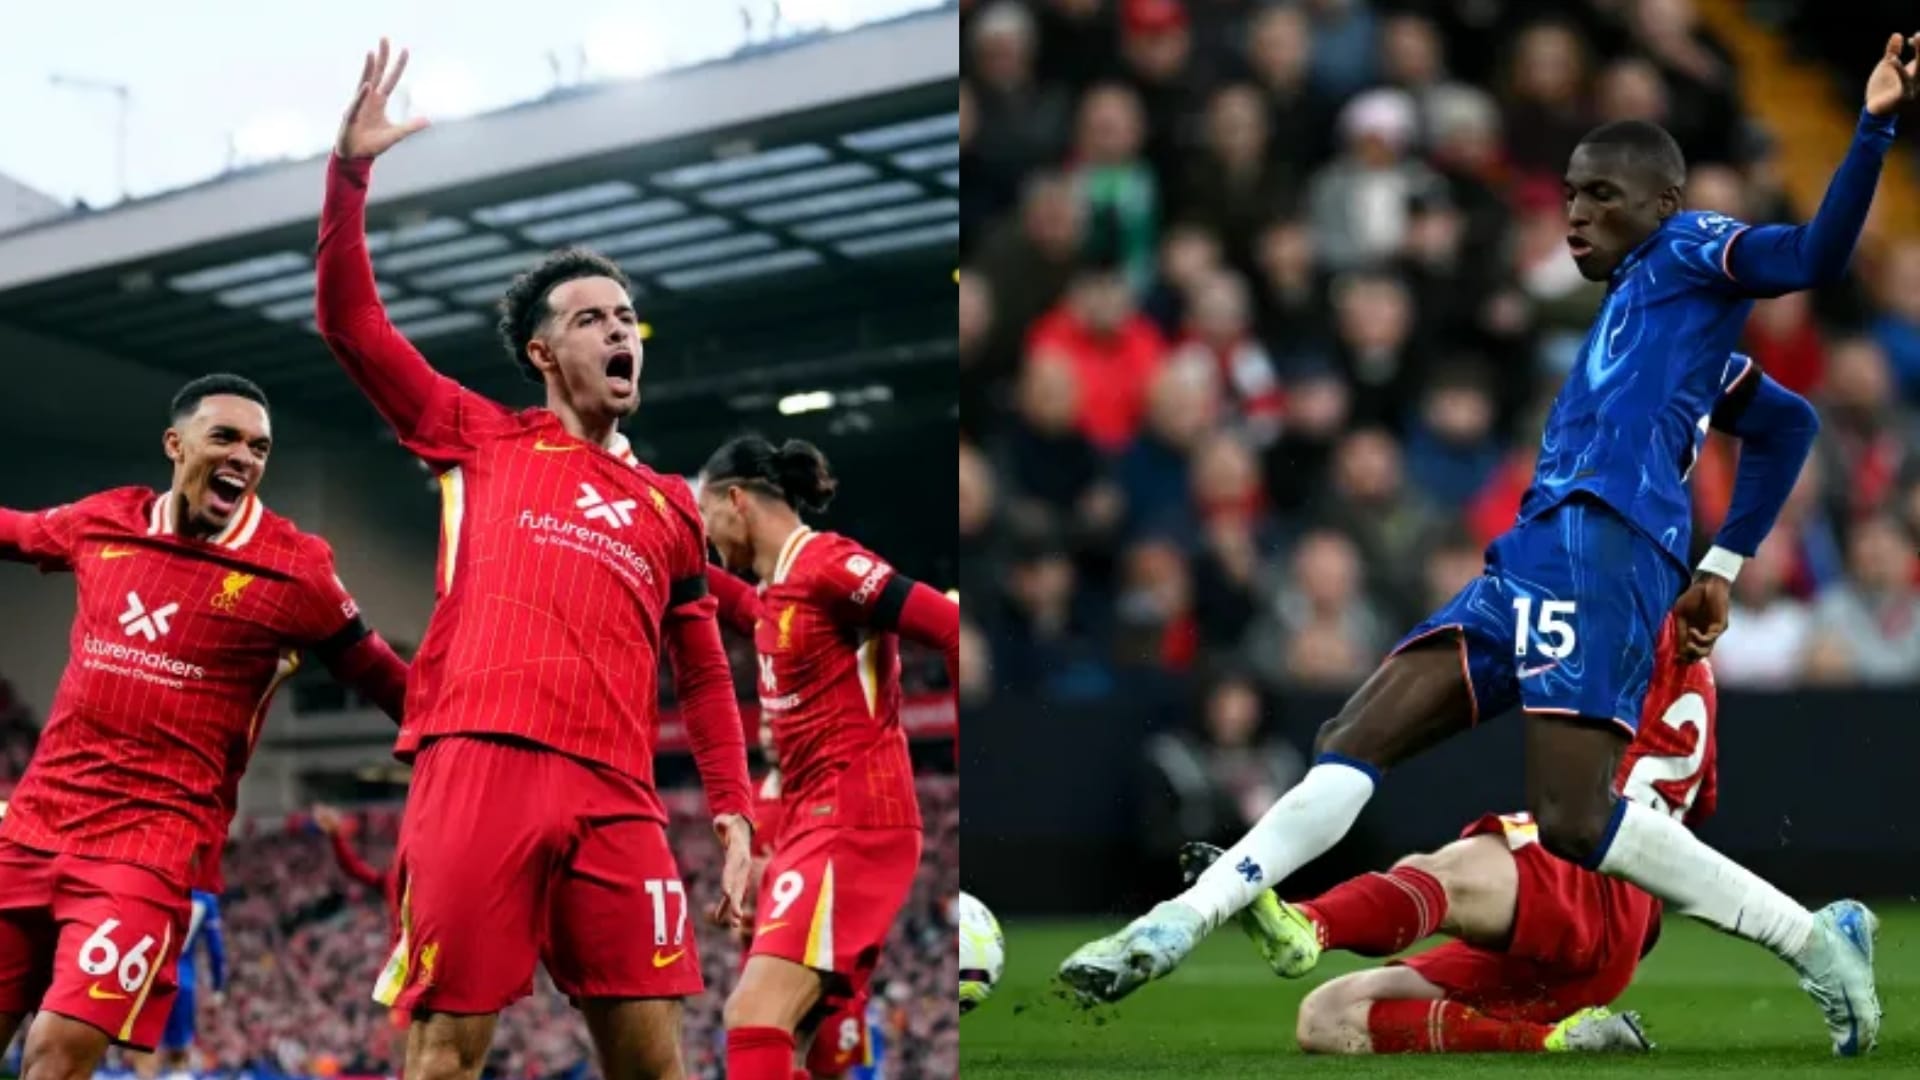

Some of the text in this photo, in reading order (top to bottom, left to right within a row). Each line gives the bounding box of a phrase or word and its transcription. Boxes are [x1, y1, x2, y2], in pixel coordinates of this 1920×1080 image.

[518, 508, 654, 585] futuremakers
[1512, 597, 1577, 659] 15
[644, 878, 687, 945] 17
[770, 870, 804, 919] 9
[78, 917, 155, 992] 66
[840, 1017, 860, 1051] 8
